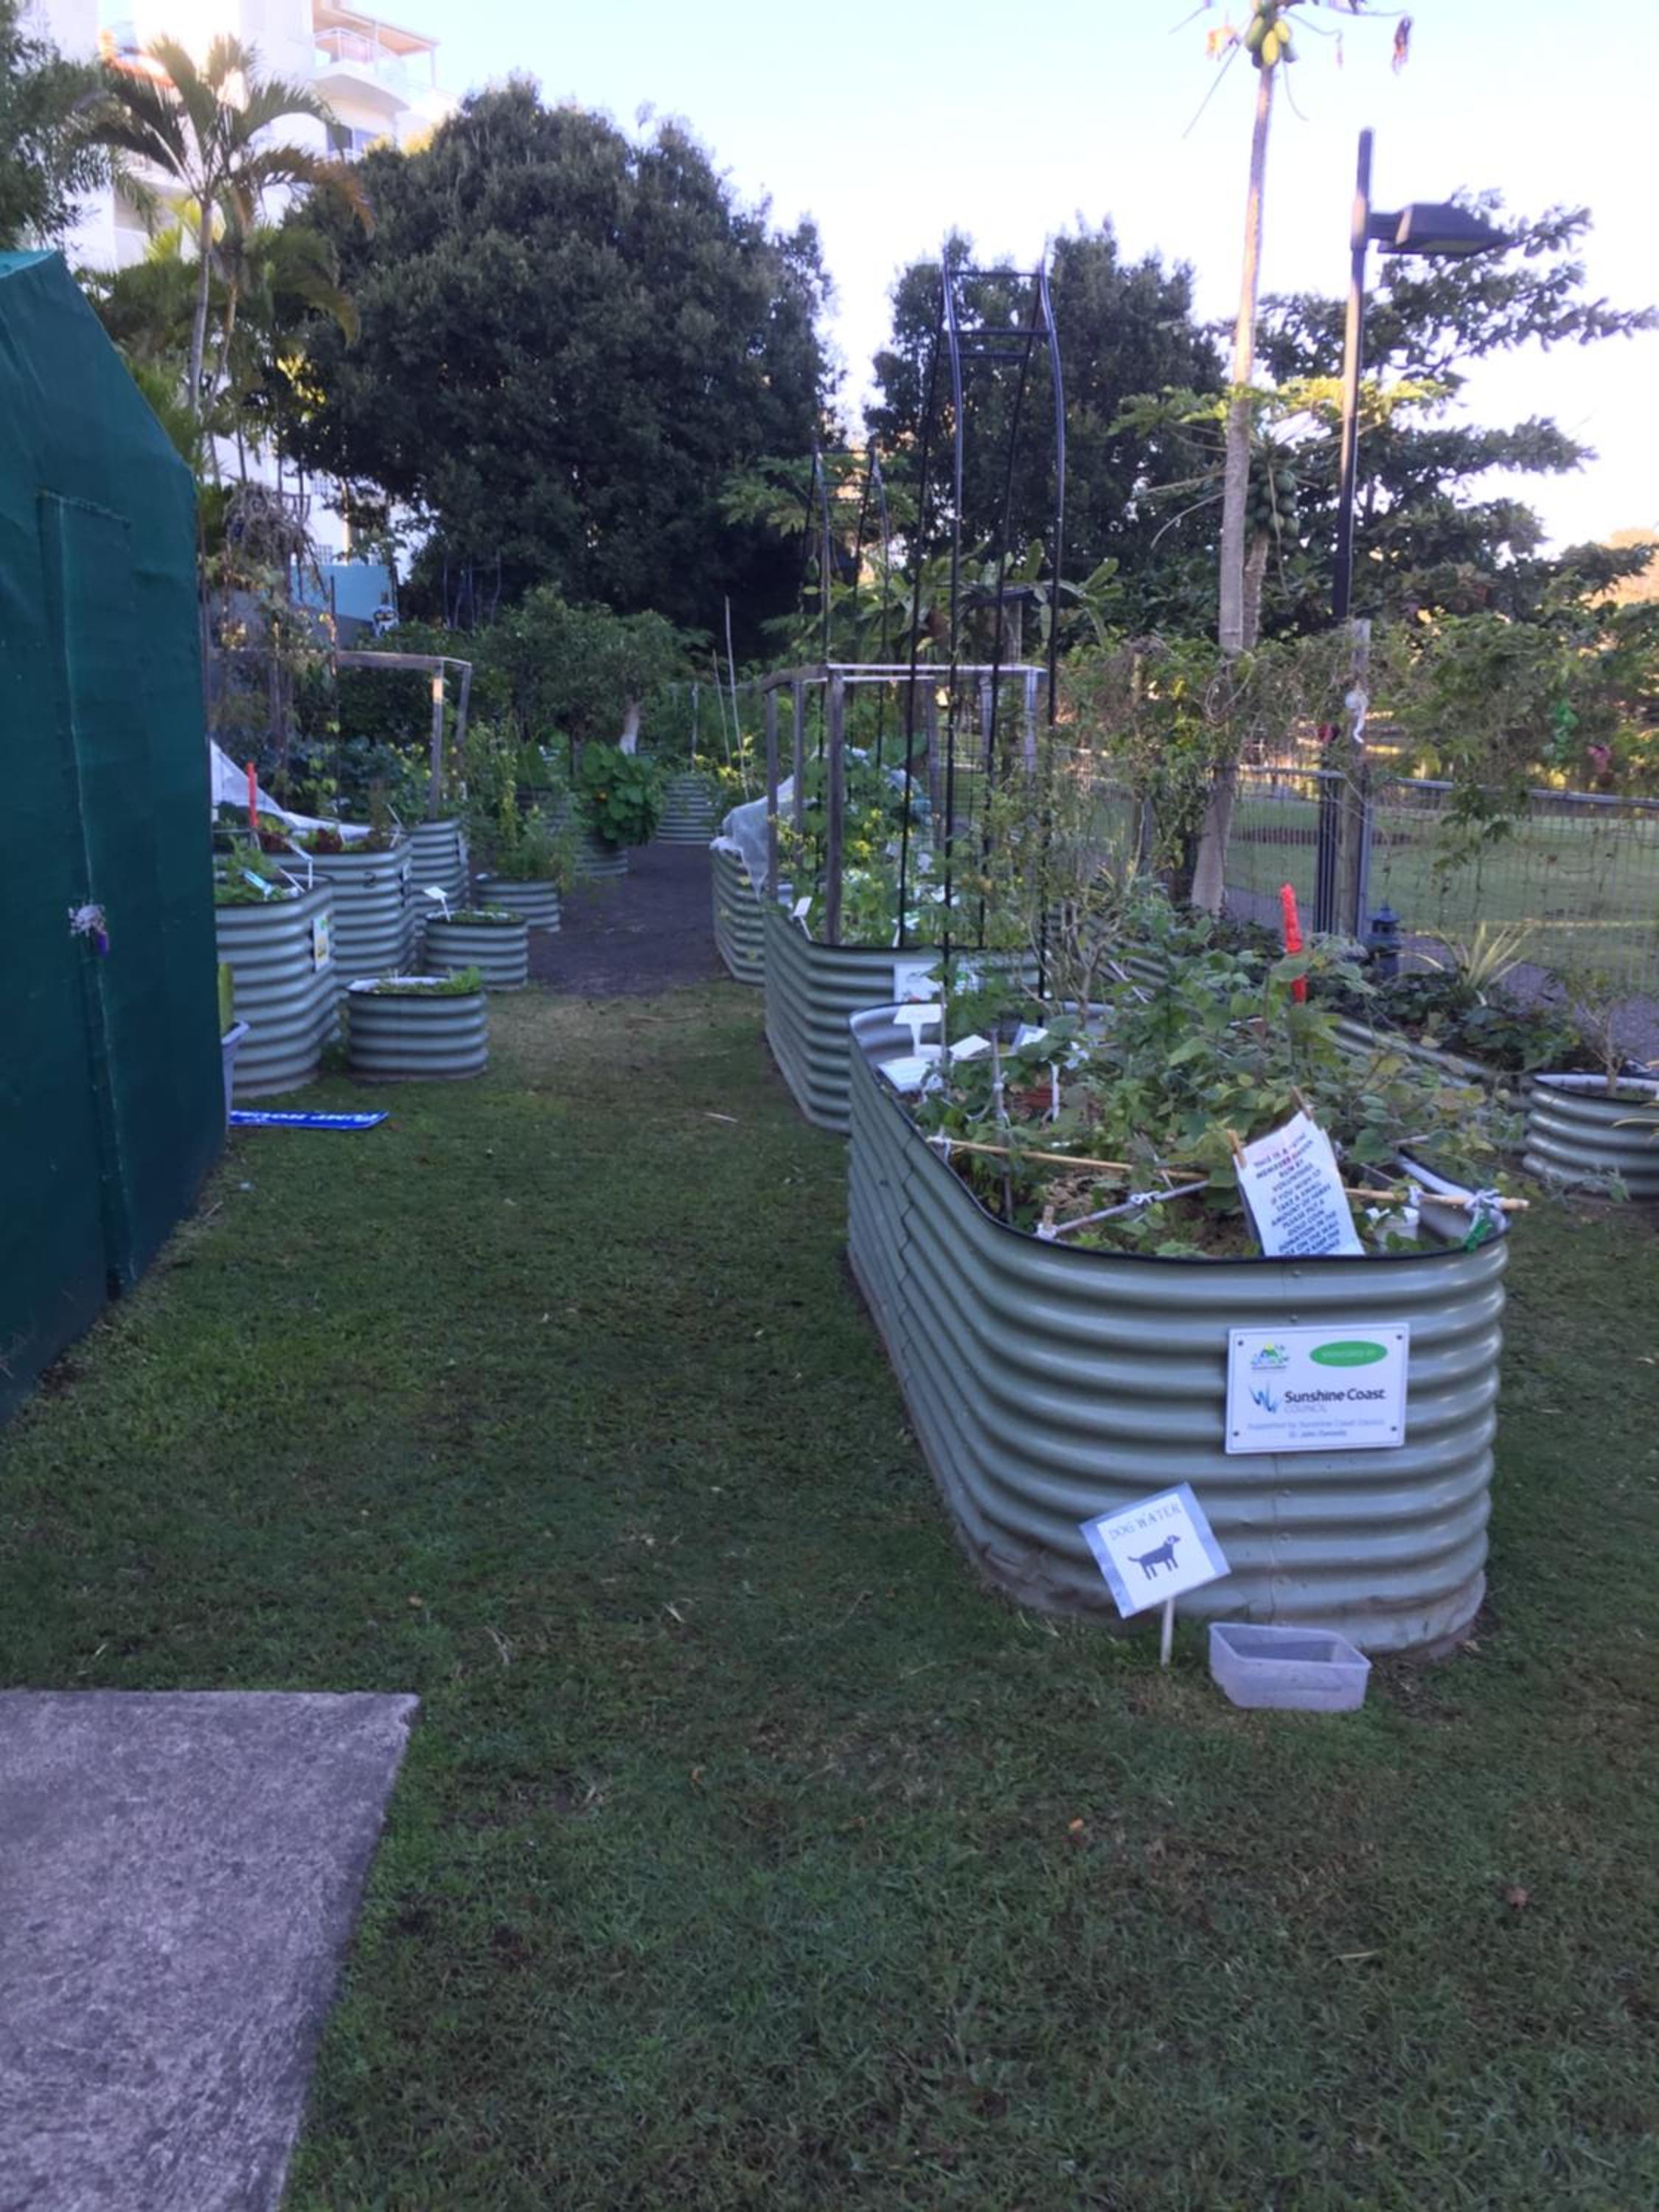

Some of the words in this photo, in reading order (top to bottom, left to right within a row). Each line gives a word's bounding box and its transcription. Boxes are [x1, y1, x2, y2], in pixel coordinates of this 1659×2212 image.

[1285, 1389, 1346, 1404] Sunshine
[1347, 1387, 1386, 1401] Coast
[1108, 1524, 1135, 1541] DOG
[1136, 1503, 1182, 1528] WATER
